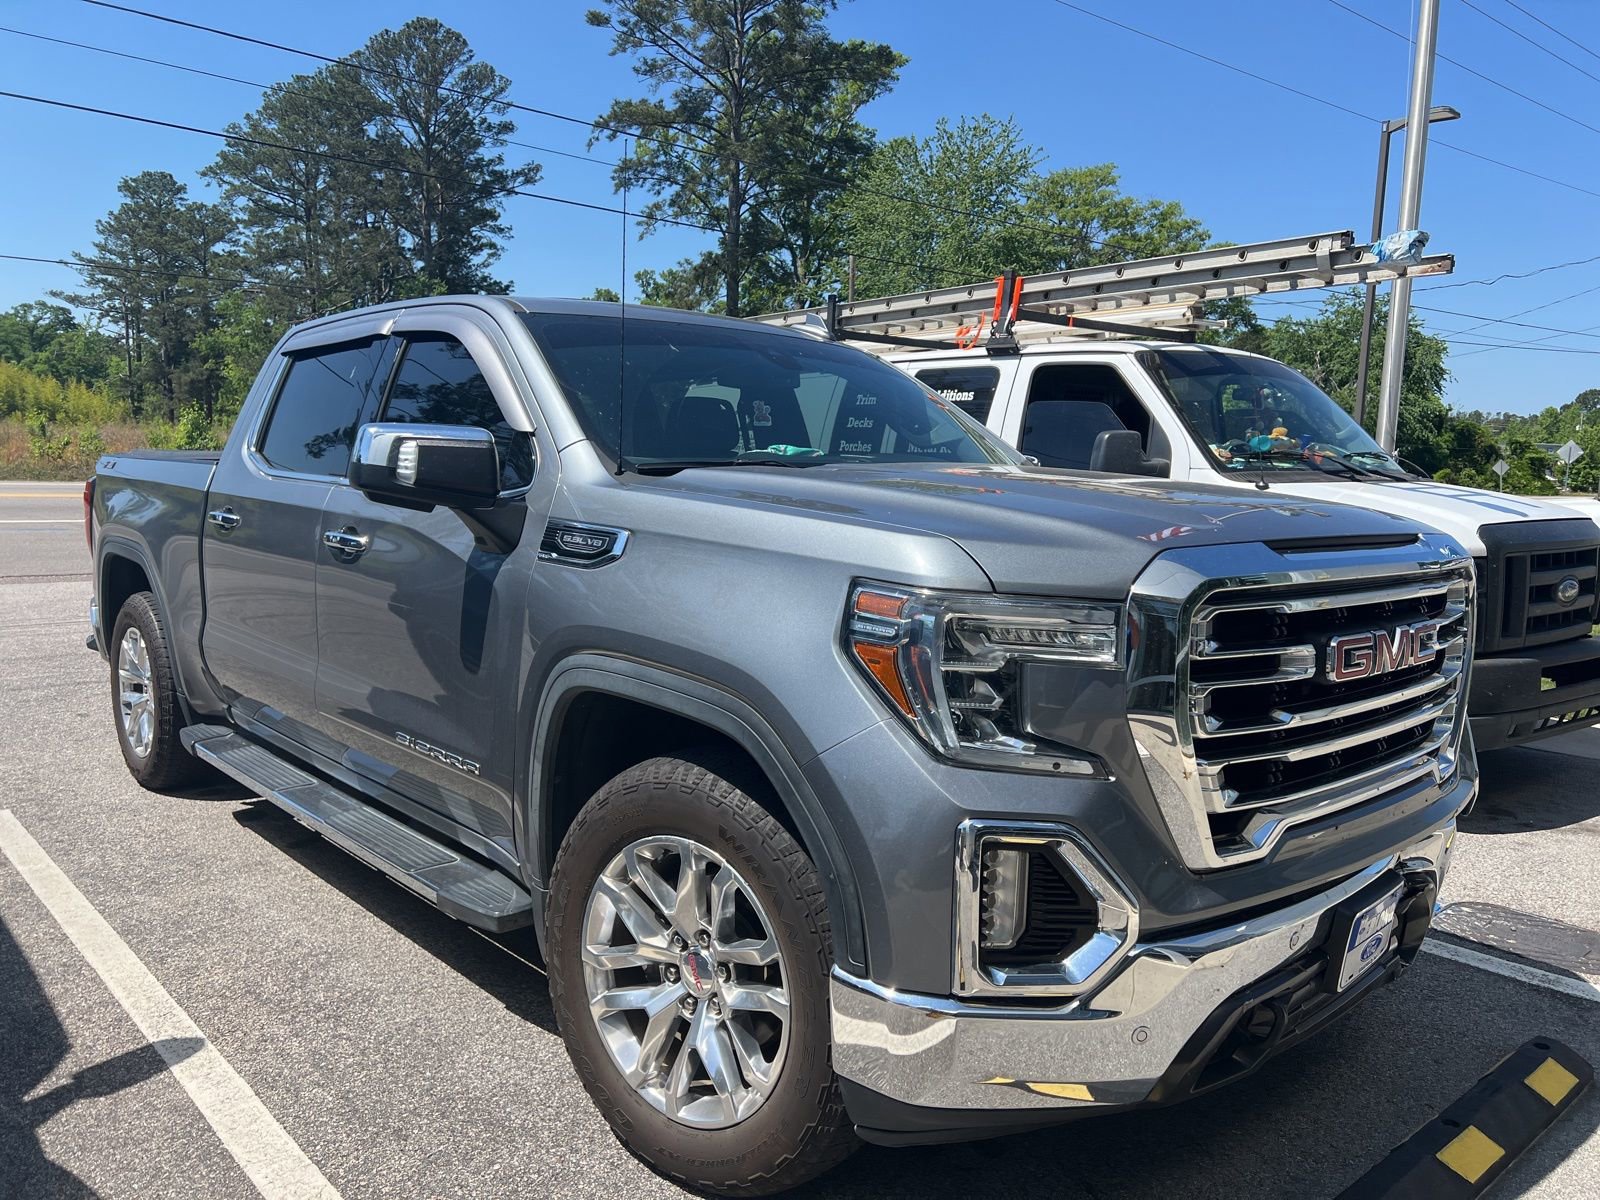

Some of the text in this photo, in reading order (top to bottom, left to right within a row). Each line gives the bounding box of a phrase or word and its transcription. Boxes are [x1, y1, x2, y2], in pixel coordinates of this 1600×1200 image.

[856, 393, 877, 405] Trim
[847, 417, 874, 428] Decks
[839, 440, 872, 452] Porches
[1328, 622, 1438, 682] GMC
[395, 731, 480, 775] SIERRA
[687, 952, 704, 992] GMC
